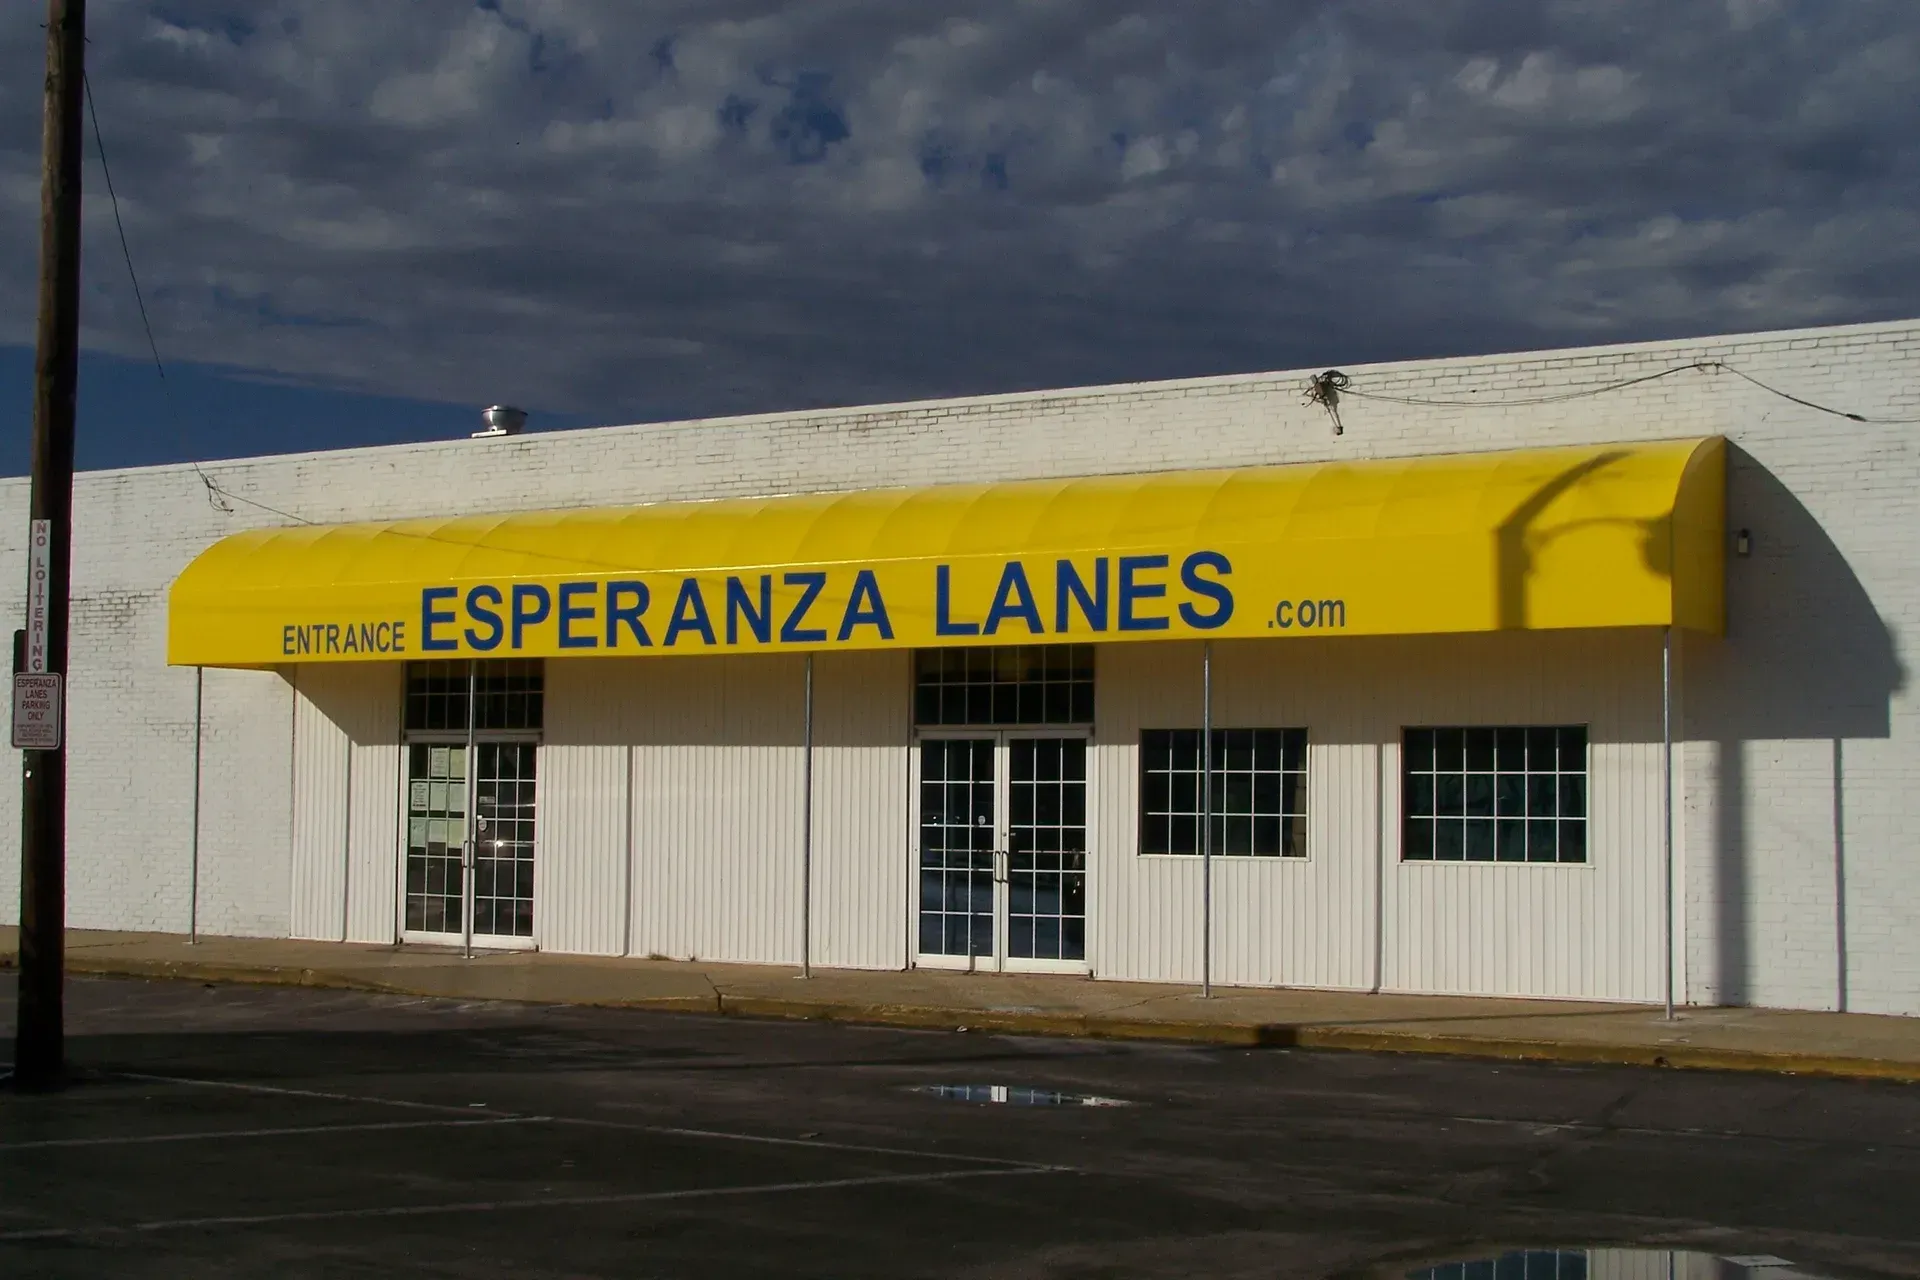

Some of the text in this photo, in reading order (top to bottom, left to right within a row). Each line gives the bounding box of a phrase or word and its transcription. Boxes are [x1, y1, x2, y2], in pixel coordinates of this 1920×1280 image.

[32, 522, 46, 671] NO LOITERING
[283, 551, 1345, 656] ENTRANCE ESPERANZA LANES .com
[17, 678, 56, 688] ESPERANZA
[25, 689, 48, 699] LANES
[22, 700, 50, 710] PARKING
[28, 711, 44, 721] ONLY
